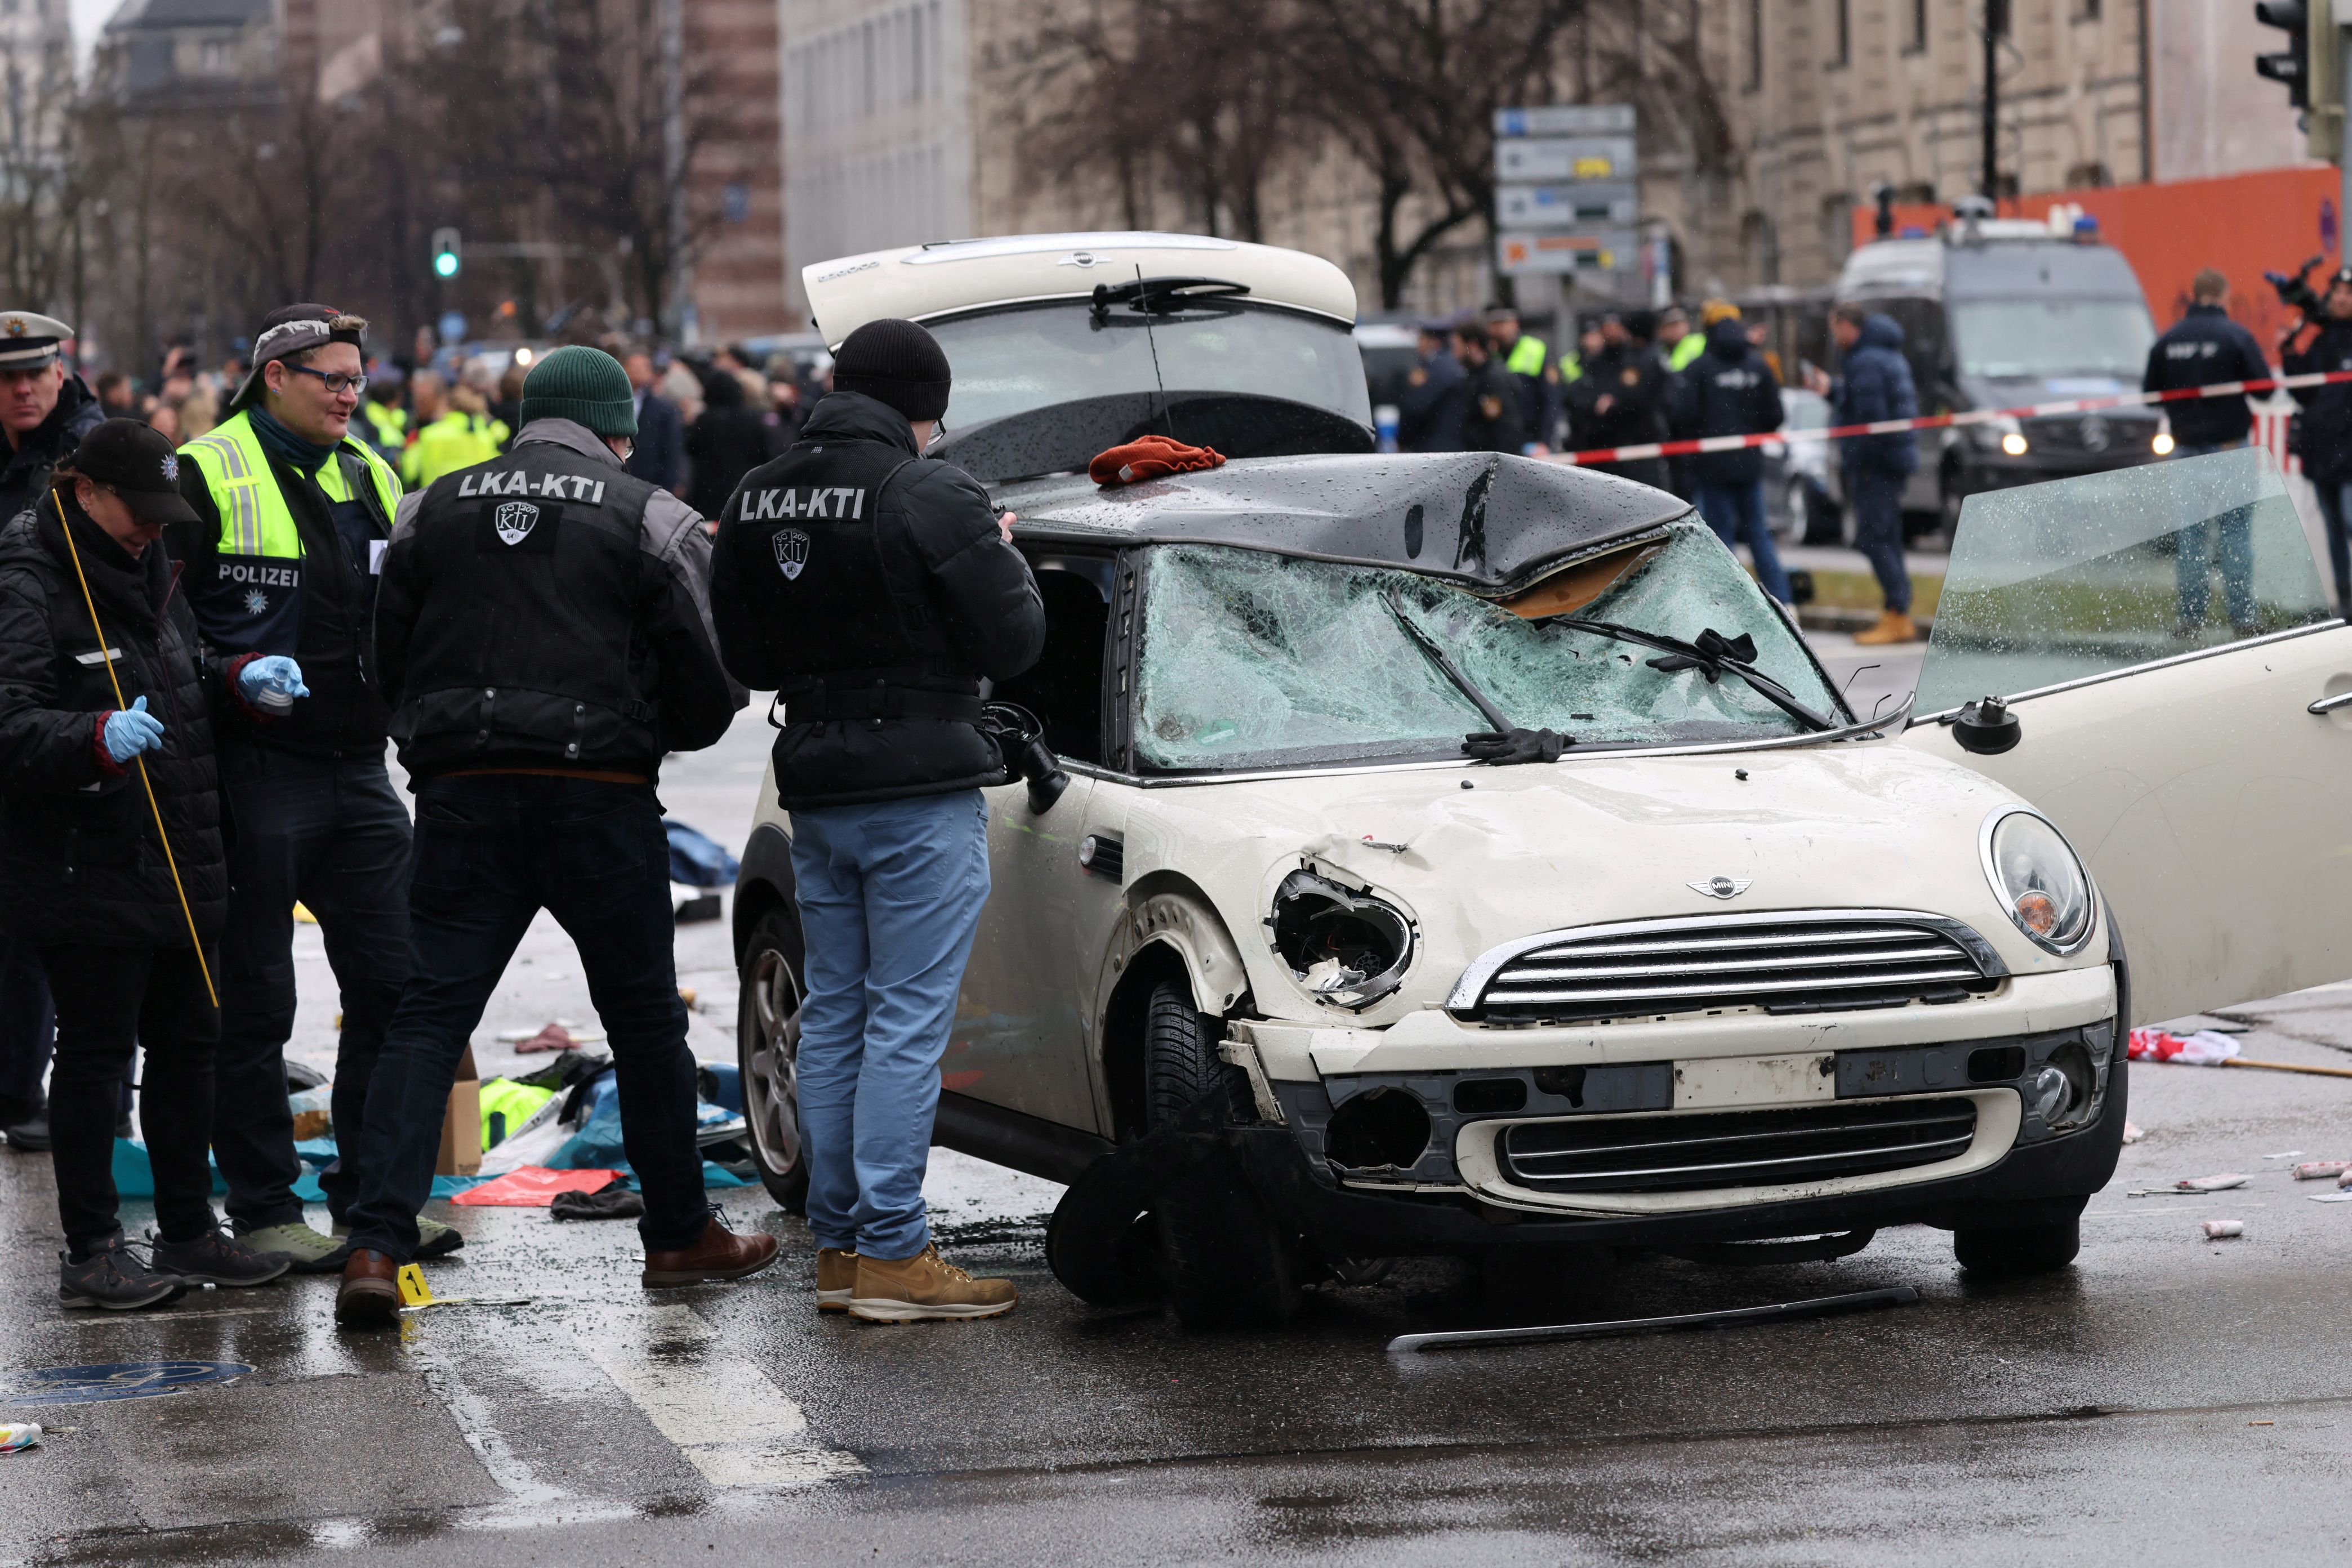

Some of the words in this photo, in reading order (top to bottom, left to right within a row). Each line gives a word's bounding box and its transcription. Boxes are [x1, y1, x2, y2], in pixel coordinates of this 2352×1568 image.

[458, 470, 605, 503] LKA-KTI
[501, 505, 515, 514] SG
[520, 505, 537, 514] 207
[740, 488, 865, 521] LKA-KTI
[777, 533, 788, 543] SG
[792, 532, 808, 542] 207
[219, 564, 299, 587] POLIZEI
[406, 1271, 421, 1296] 1
